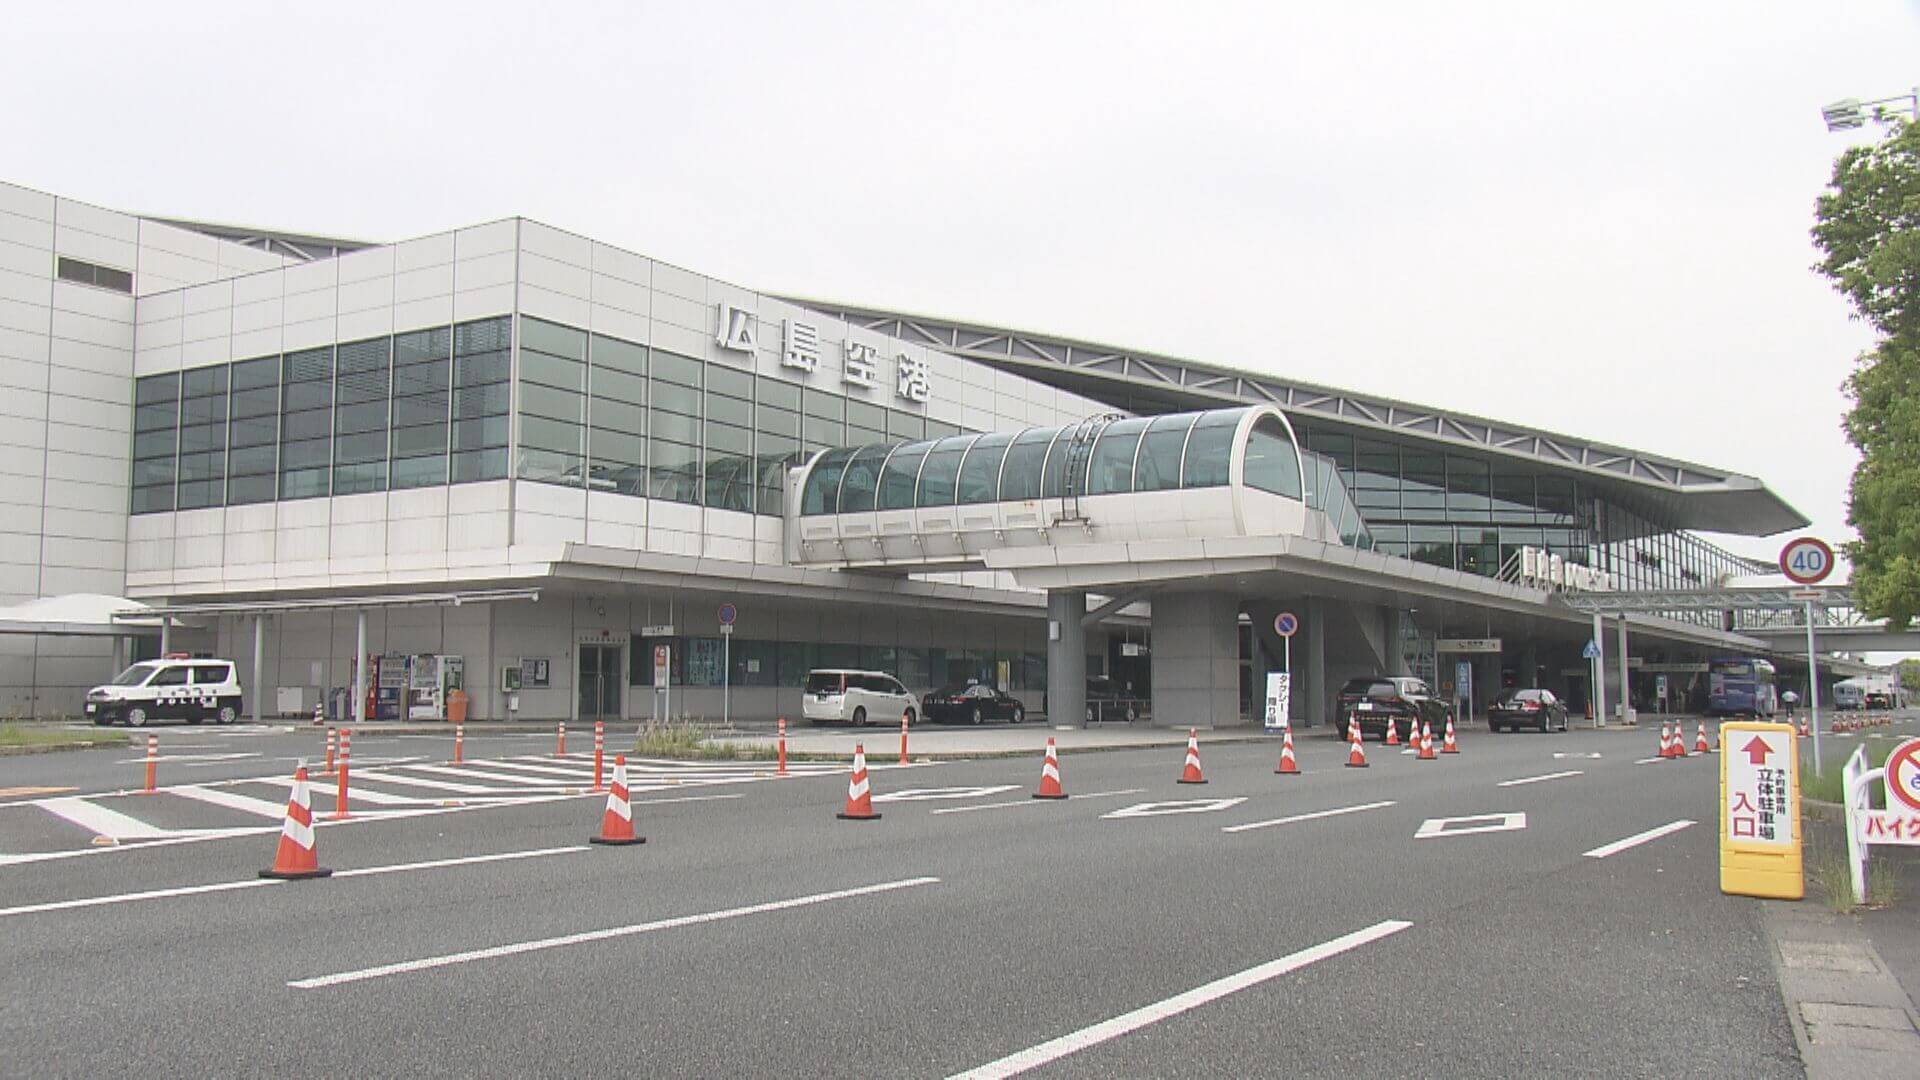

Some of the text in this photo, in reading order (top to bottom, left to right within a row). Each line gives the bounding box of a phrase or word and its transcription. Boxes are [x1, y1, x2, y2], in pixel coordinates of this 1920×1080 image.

[716, 301, 930, 402] 広島空港
[1792, 551, 1822, 571] 40
[1732, 792, 1756, 837] 入口
[1757, 768, 1775, 840] 立体駐車場
